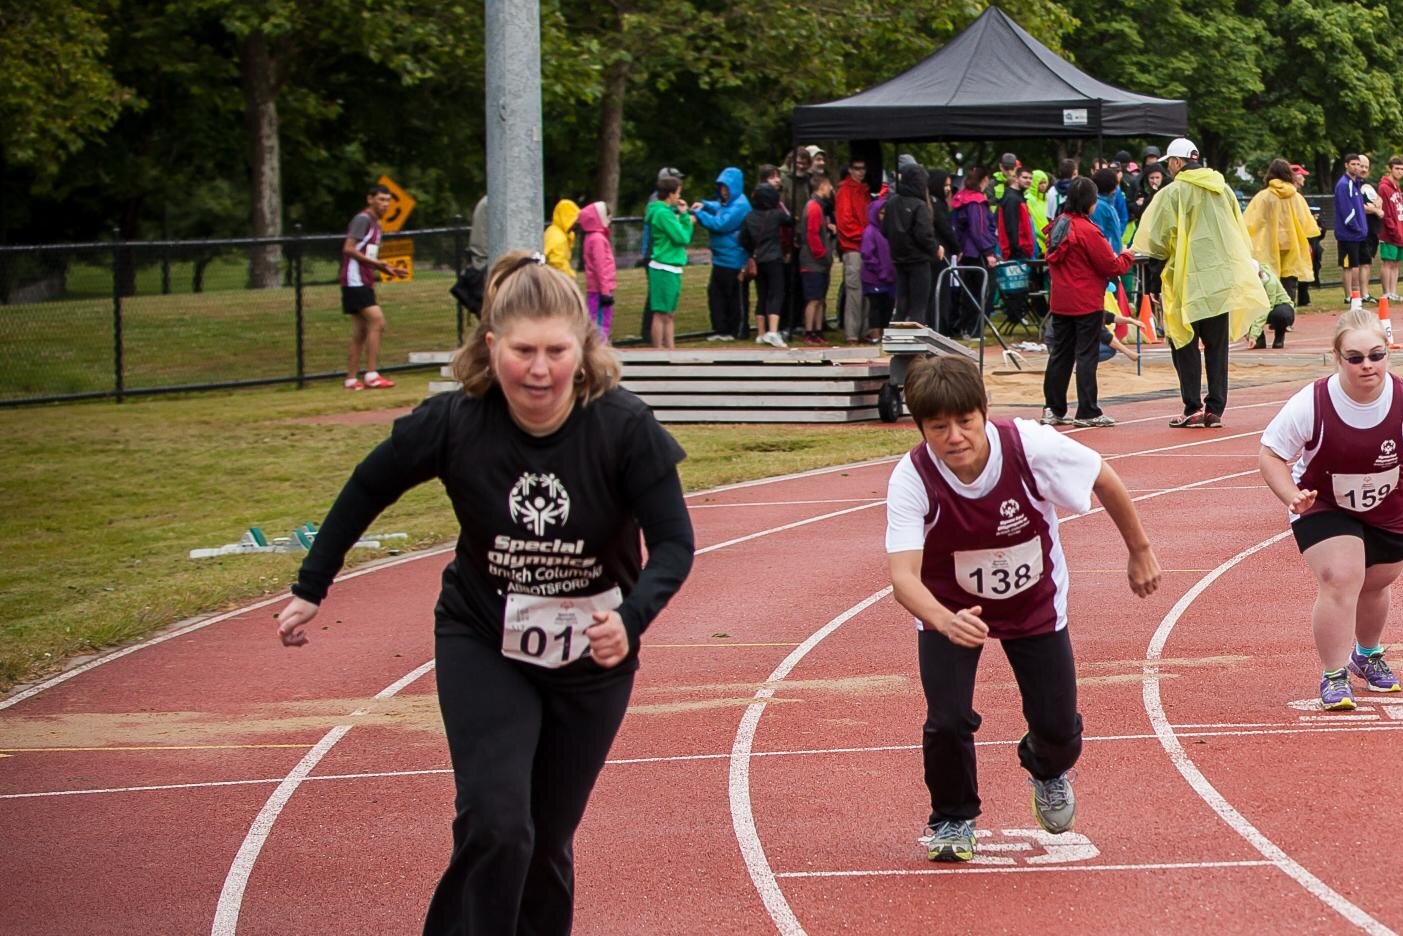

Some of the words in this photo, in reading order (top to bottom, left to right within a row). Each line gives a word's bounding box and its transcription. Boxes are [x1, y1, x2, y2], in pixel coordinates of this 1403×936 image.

[1344, 484, 1391, 508] 159
[494, 535, 584, 553] Special
[488, 551, 597, 568] Olympics
[969, 564, 1031, 594] 138
[520, 626, 588, 661] 01
